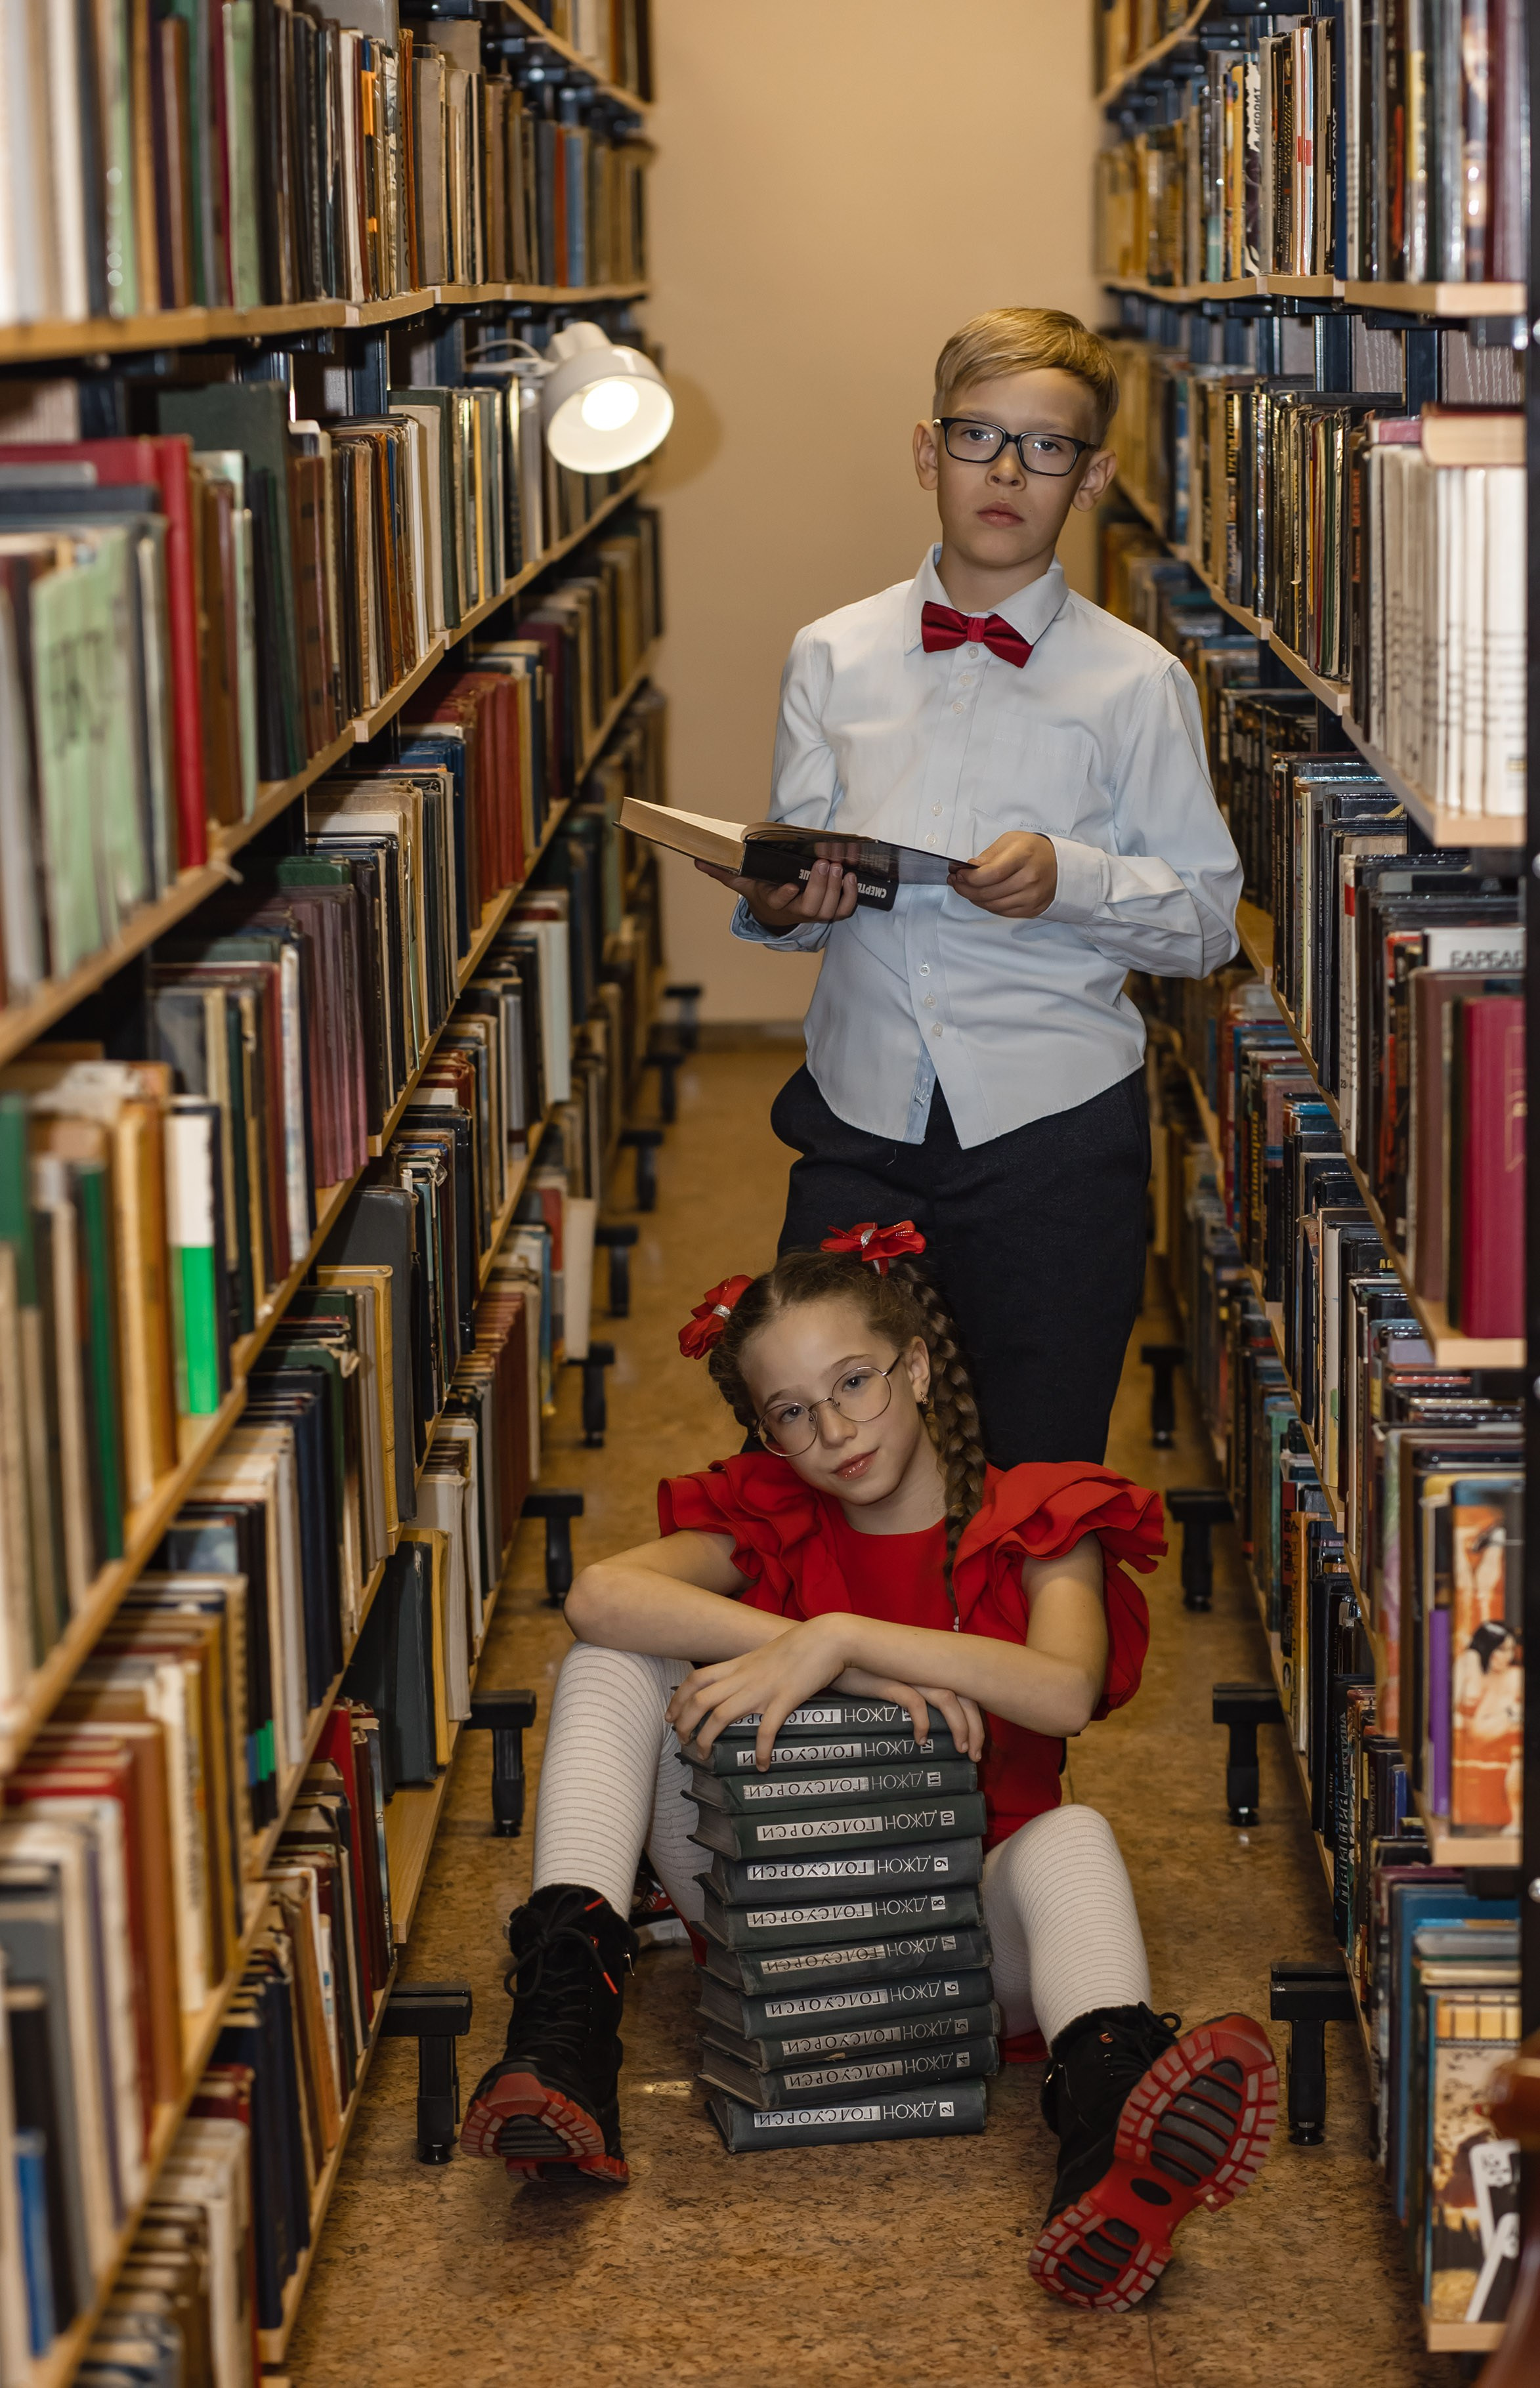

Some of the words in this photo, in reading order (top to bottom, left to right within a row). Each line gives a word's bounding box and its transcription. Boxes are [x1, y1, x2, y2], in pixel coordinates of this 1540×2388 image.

[857, 883, 887, 899] СМЕРТЬ
[844, 1705, 899, 1723] ДЖОН
[742, 1746, 854, 1765] ГОЛСУОРИ
[865, 1739, 915, 1757] ДЖОН
[872, 1770, 924, 1791] ДЖОН
[928, 1773, 939, 1785] 11
[749, 1780, 862, 1798] ГОЛСУОРСИ
[886, 1810, 937, 1830] ДЖОН
[942, 1812, 954, 1825] 10
[762, 1818, 876, 1839] ГОЛСУОРСИ
[752, 1861, 868, 1879] ГОЛСУОРСИ
[878, 1856, 931, 1873] ДЖОН
[935, 1859, 947, 1869] 9
[875, 1895, 928, 1916] ДЖОН
[933, 1898, 944, 1908] 8
[753, 1906, 865, 1925] ГОЛСУОРСИ
[886, 1936, 938, 1957] ДЖОН
[767, 1948, 878, 1972] ГОЛСУОРСИ
[889, 1980, 941, 2003] ДЖОН
[947, 1983, 958, 1993] 6
[771, 1992, 881, 2015] ГОЛСУОРСИ
[903, 2018, 952, 2040] ДЖОН
[956, 2020, 966, 2031] 5
[788, 2028, 894, 2053] ГОЛСУОРСИ
[905, 2053, 953, 2074] ДЖОН
[957, 2053, 969, 2065] 4
[789, 2062, 896, 2087] ГОЛСУОРСИ
[759, 2106, 873, 2125] ГОЛСУОРСИ
[883, 2100, 937, 2120] ДЖОН
[941, 2104, 952, 2115] 2
